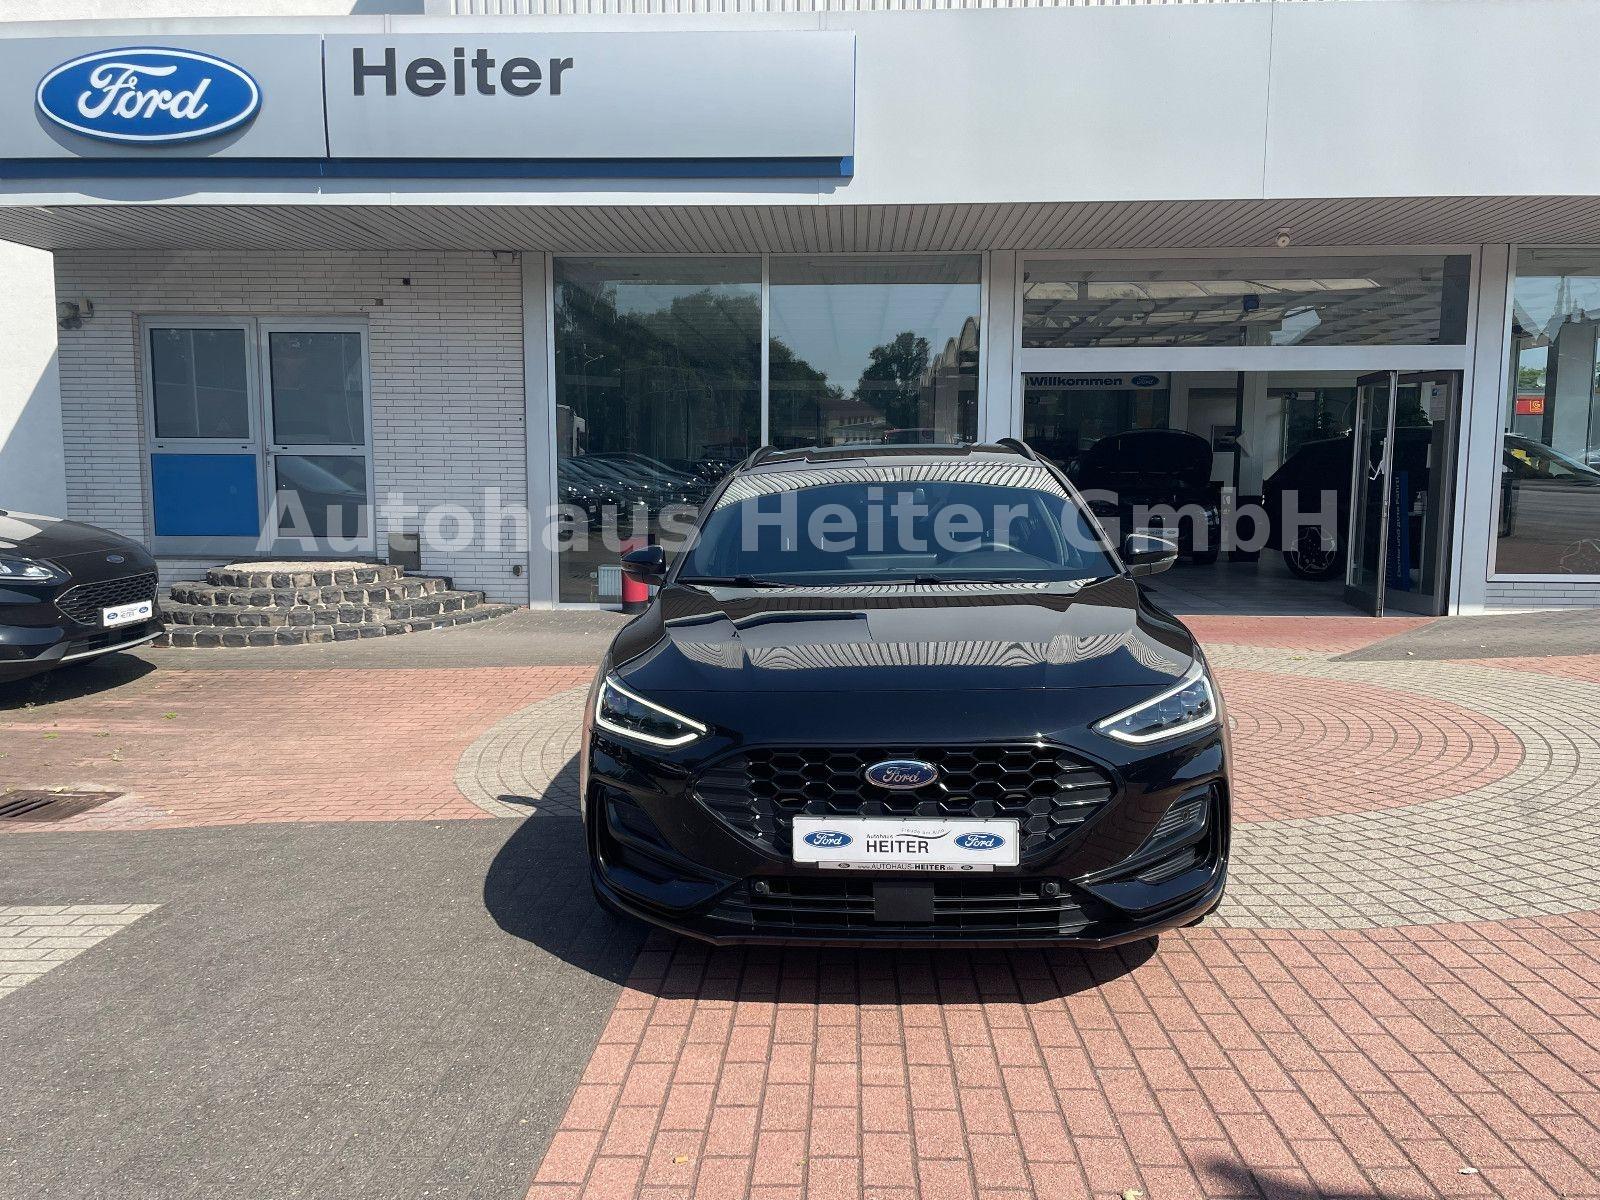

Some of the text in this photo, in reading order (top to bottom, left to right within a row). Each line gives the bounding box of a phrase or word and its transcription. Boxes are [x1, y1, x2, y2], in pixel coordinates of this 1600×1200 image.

[352, 47, 574, 97] Heiter
[77, 62, 209, 120] Ford
[1028, 375, 1123, 387] Willkommen
[882, 766, 921, 783] Ford
[813, 832, 842, 846] Ford
[964, 834, 994, 848] Ford
[866, 840, 929, 853] HEITER
[857, 863, 954, 871] www.AUTOHAUS-HEITER.de
